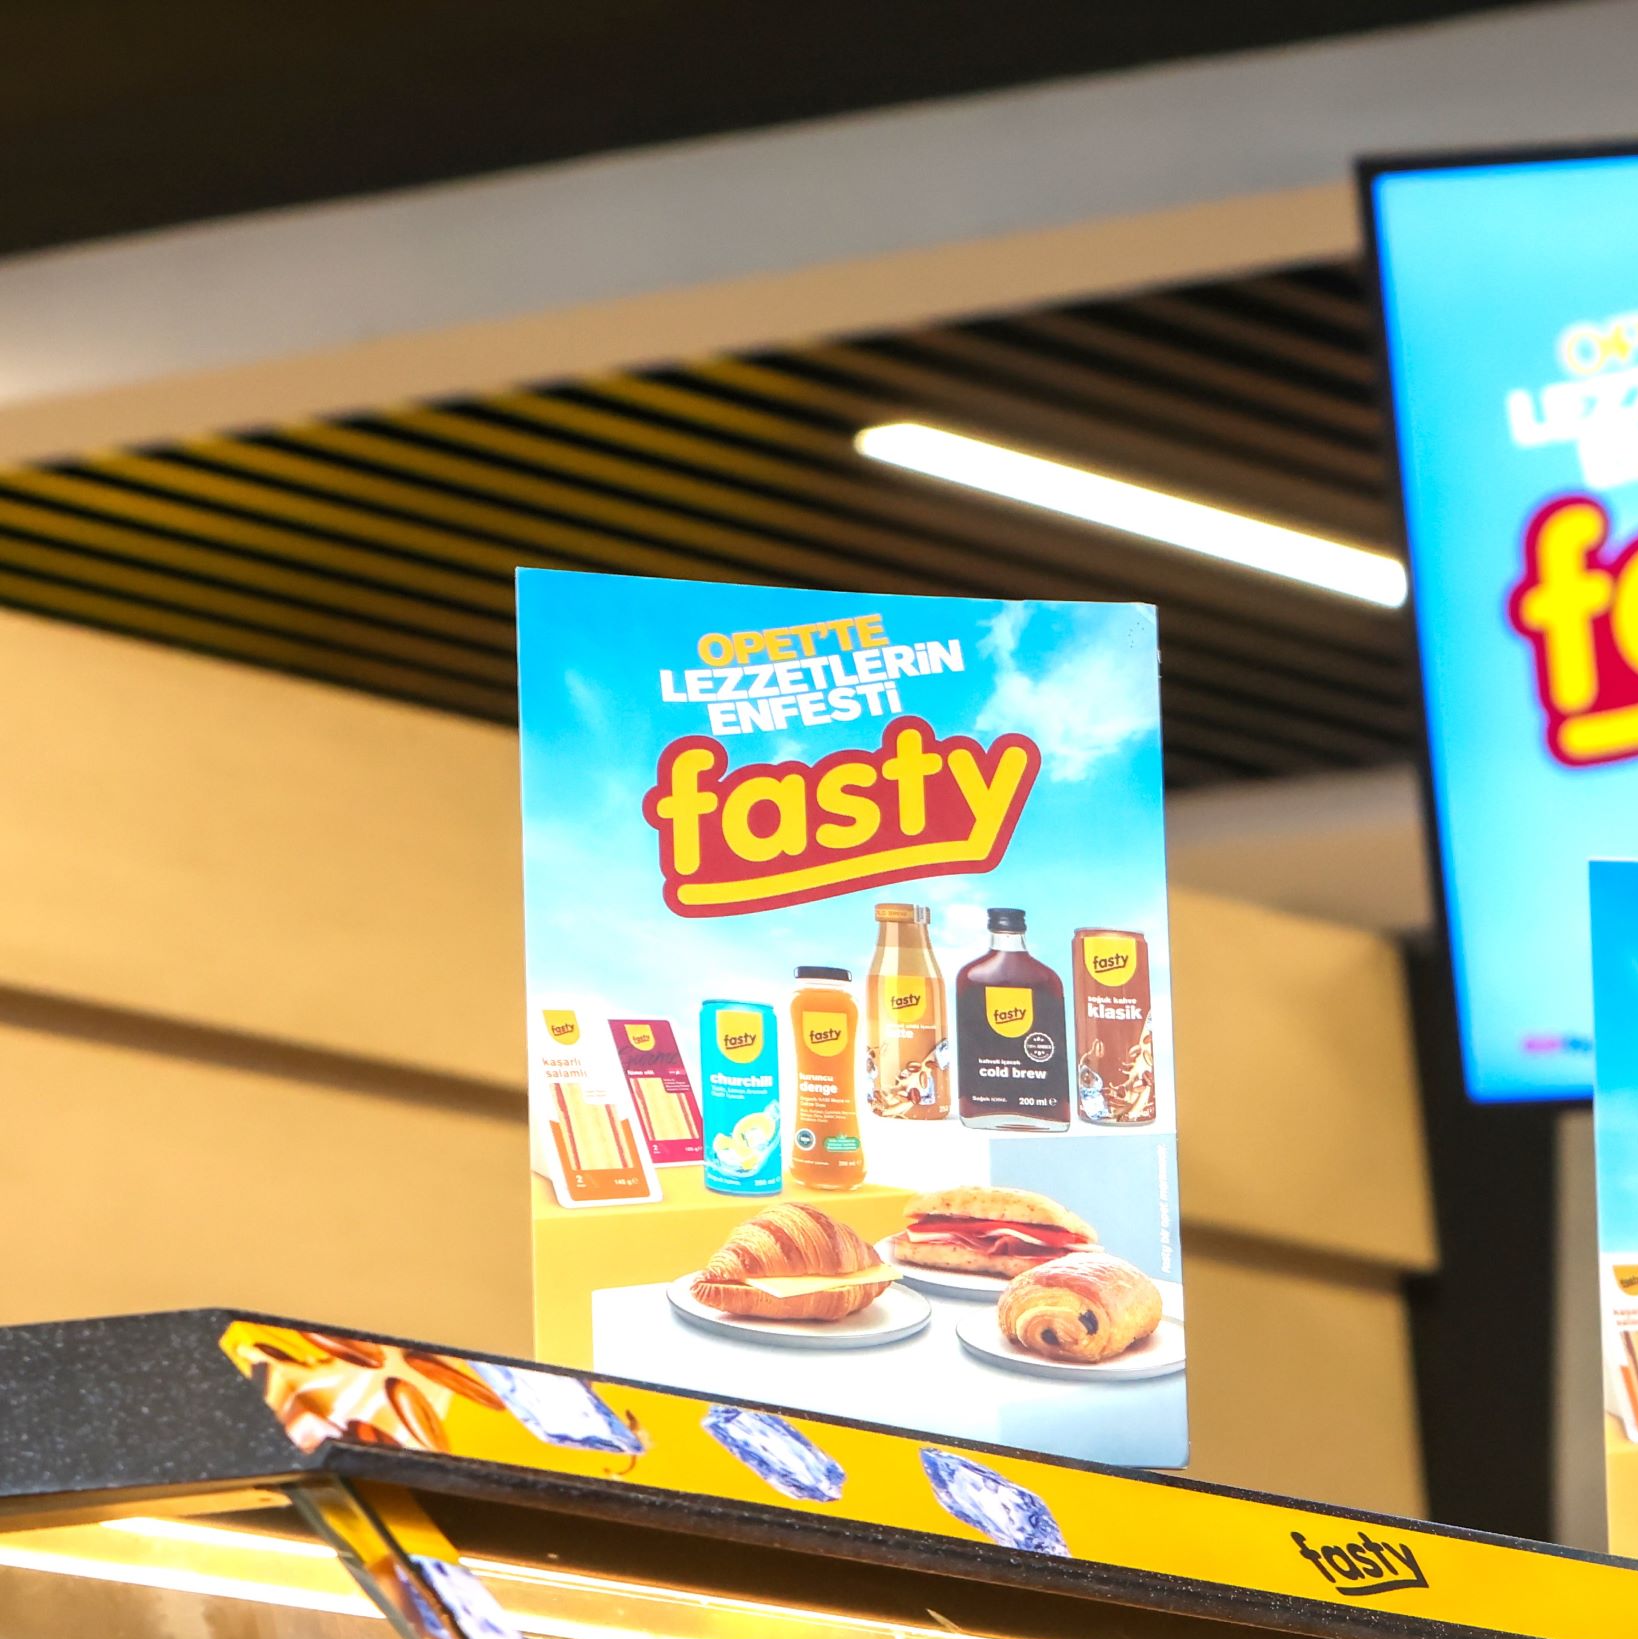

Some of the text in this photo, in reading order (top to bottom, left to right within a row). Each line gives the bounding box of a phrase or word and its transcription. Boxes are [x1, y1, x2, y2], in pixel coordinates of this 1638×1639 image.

[697, 614, 890, 668] OPET'TE
[655, 728, 1029, 905] fasty
[1093, 953, 1129, 974] fasty
[891, 993, 921, 1010] fasty
[994, 1007, 1026, 1024] fasty
[1087, 1003, 1143, 1020] klasik
[724, 1032, 757, 1050] fasty
[809, 1028, 842, 1045] fasty
[710, 1073, 773, 1088] churchill
[979, 1066, 1047, 1079] cold brew
[799, 1081, 839, 1096] denge
[1018, 1097, 1035, 1106] 200
[1290, 1531, 1430, 1597] fasty
